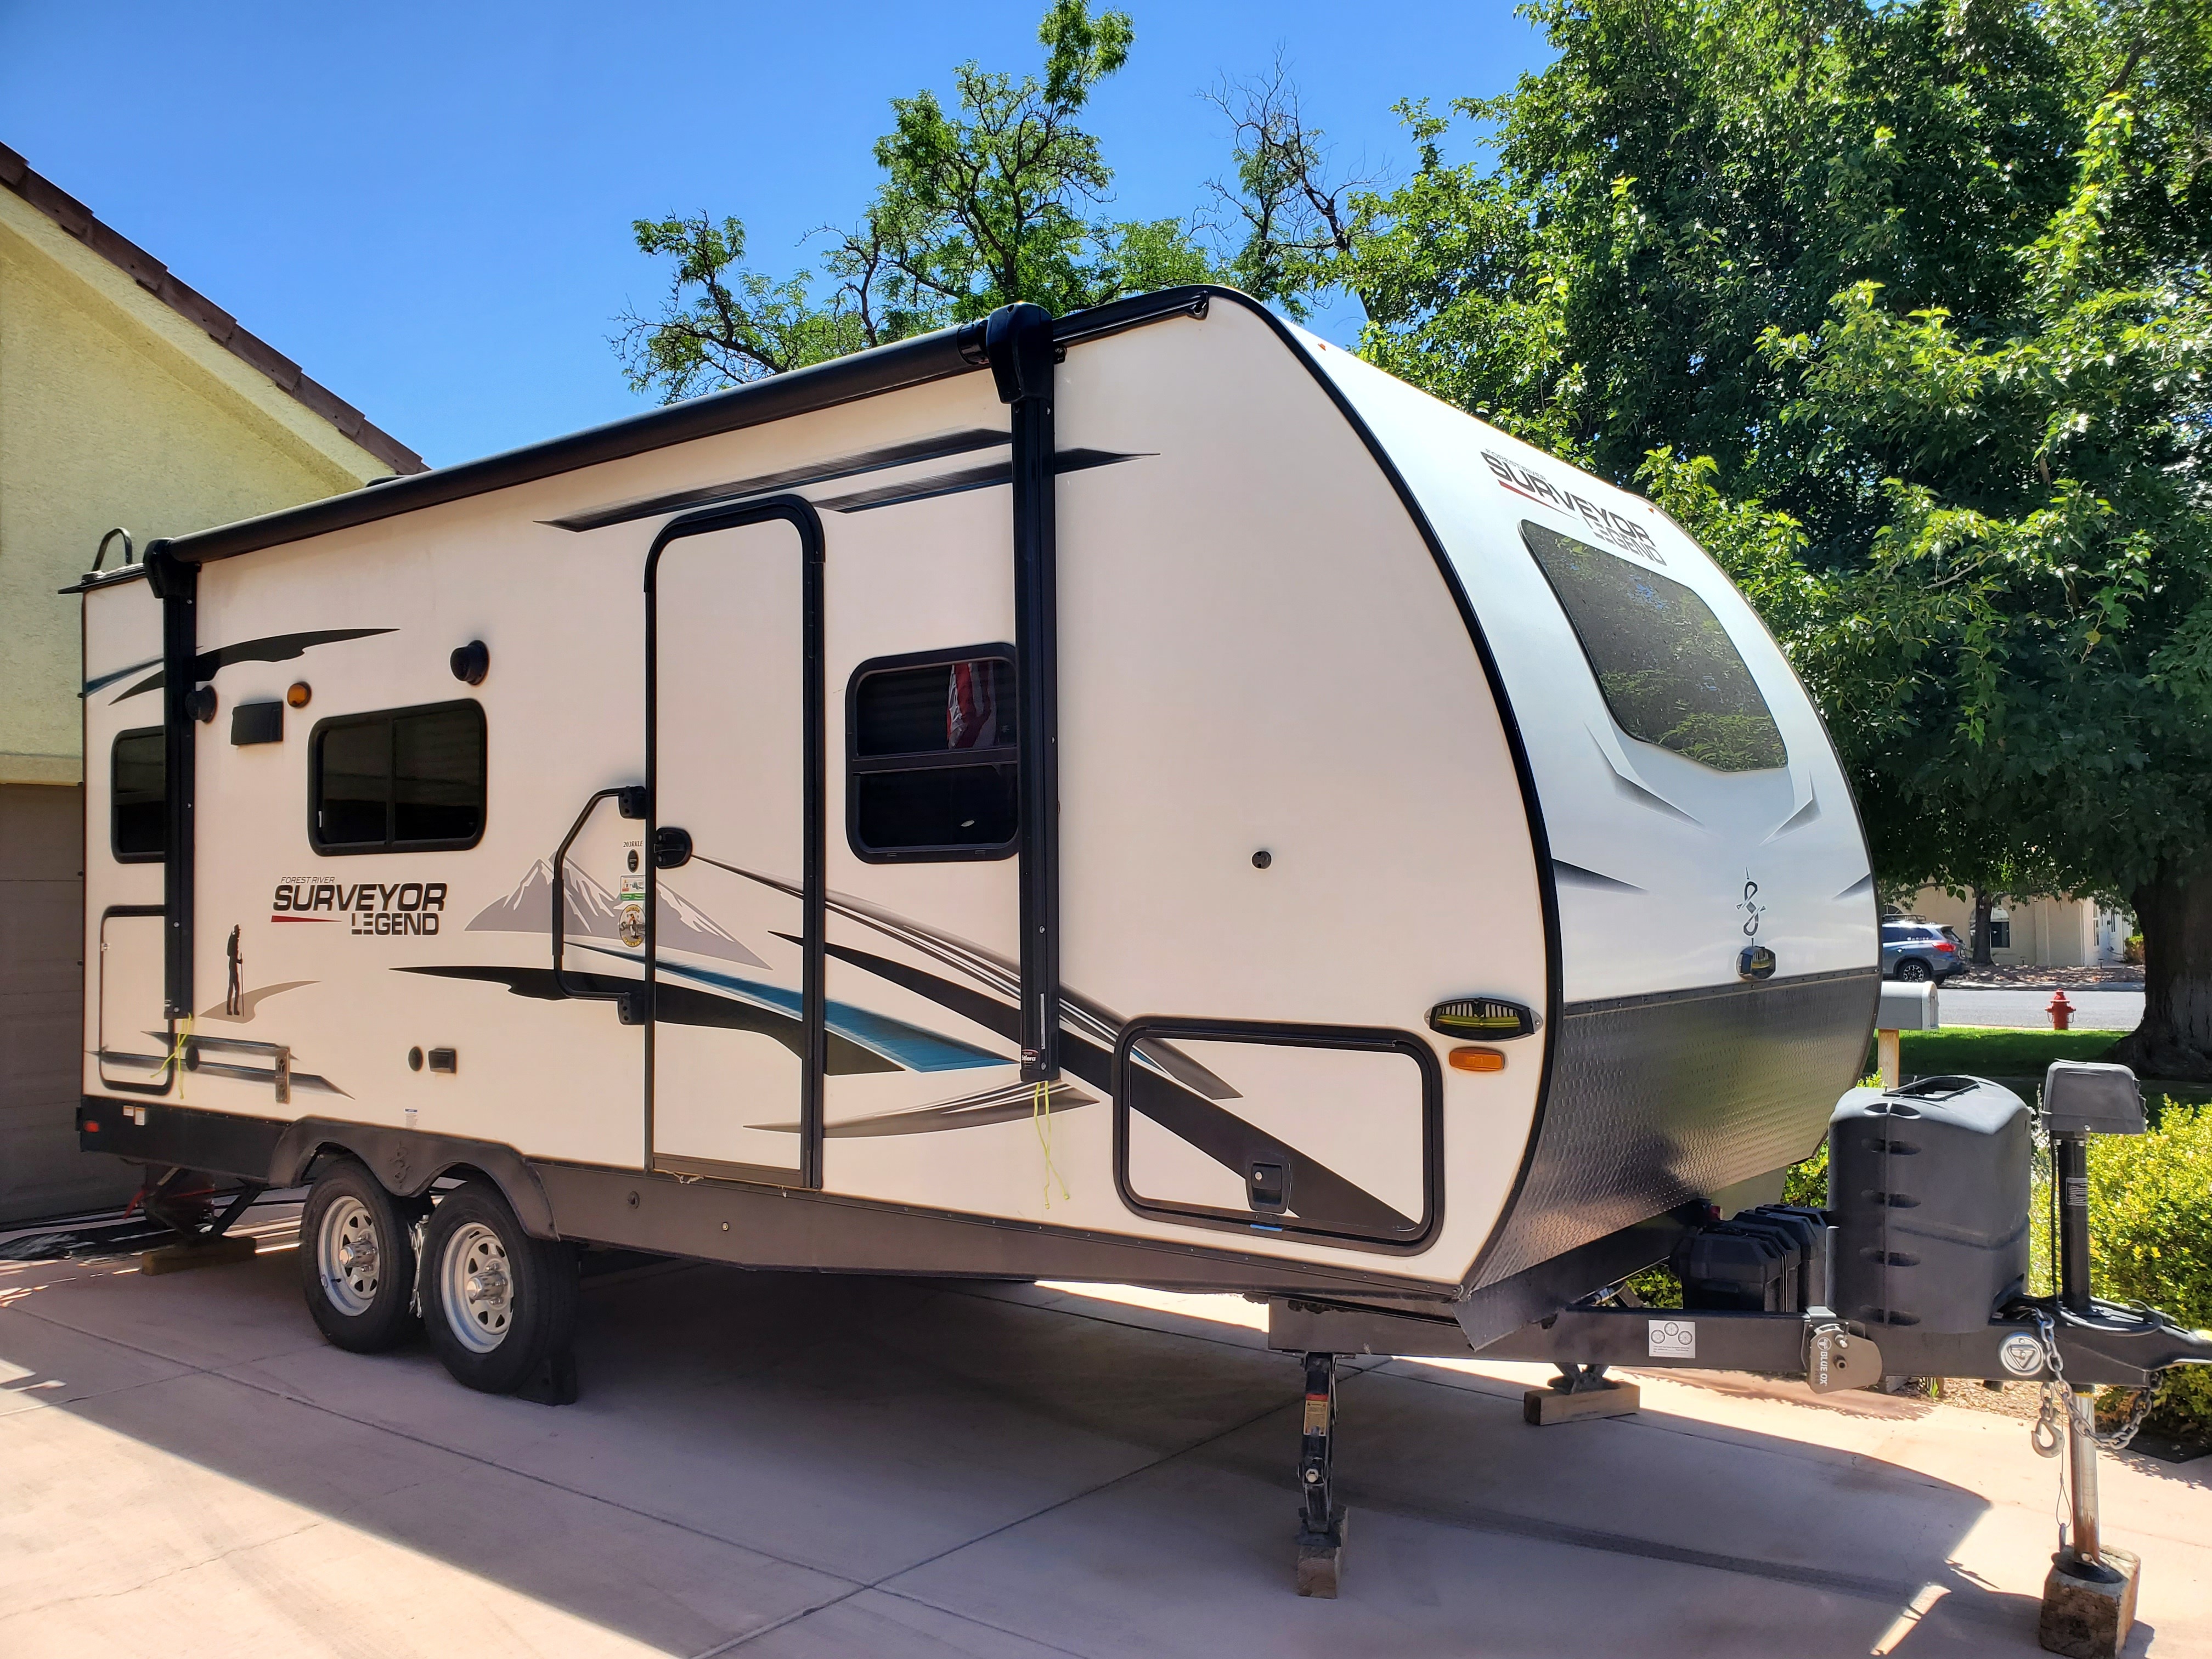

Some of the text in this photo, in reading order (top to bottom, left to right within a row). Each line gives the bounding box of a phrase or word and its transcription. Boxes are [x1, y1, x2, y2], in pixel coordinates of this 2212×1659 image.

[1480, 451, 1657, 548] SURVEYOR
[1581, 515, 1668, 567] LEGEND
[273, 883, 448, 911] SURVEYOR
[351, 912, 439, 935] LEGEND
[1820, 1351, 1828, 1372] BLUE
